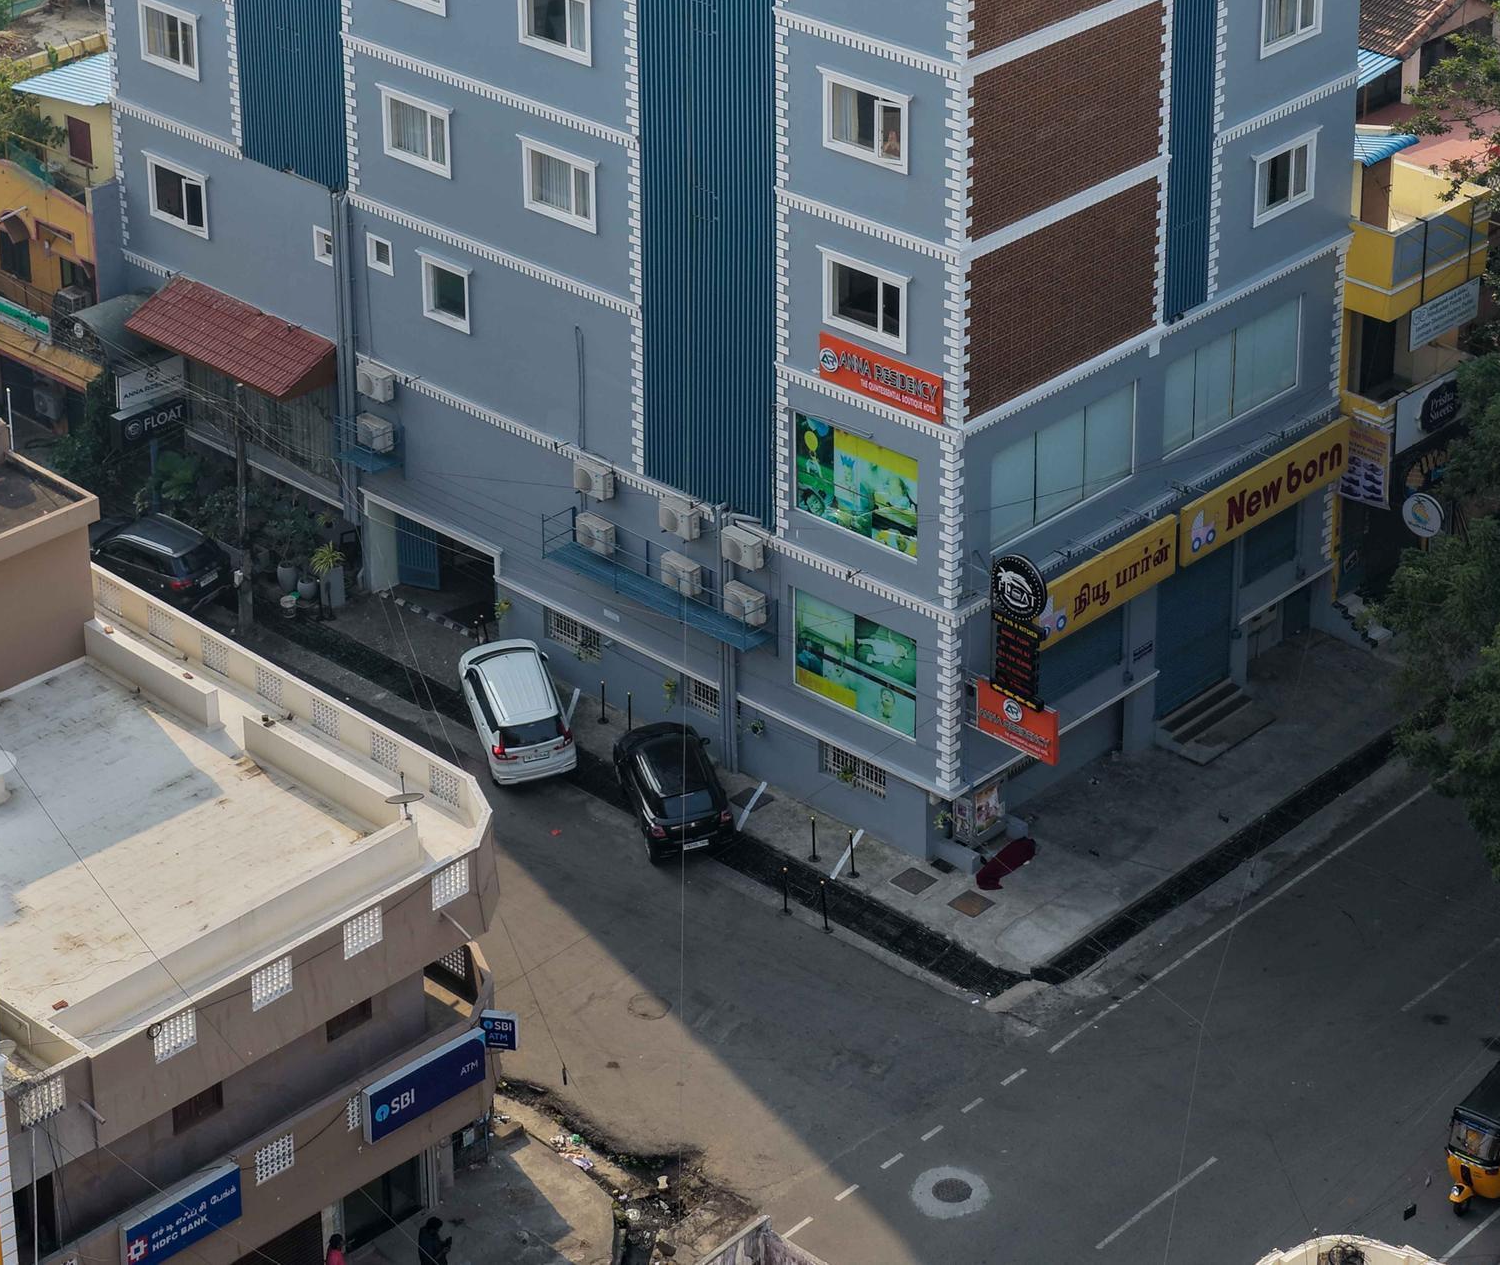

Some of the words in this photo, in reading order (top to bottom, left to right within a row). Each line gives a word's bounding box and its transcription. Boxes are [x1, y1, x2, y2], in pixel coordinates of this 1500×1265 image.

[838, 350, 872, 380] ANNA
[873, 362, 940, 403] RESIDENCY
[123, 388, 144, 400] ANNA
[901, 394, 924, 410] BOUTIQUE
[923, 402, 938, 415] HOTEL
[1430, 389, 1455, 411] Prisha
[143, 404, 184, 431] FLOAT
[1429, 402, 1455, 423] Sweets
[1225, 476, 1283, 531] New
[1286, 442, 1343, 494] born
[1073, 580, 1110, 621] நியூ
[1115, 538, 1172, 589] பார்ன்
[994, 613, 1003, 622] THE
[1018, 626, 1039, 639] KITCHEN
[488, 1032, 508, 1042] ATM
[494, 1020, 513, 1032] SBI
[390, 1088, 416, 1115] SBI
[459, 1059, 479, 1077] ATM
[151, 1231, 179, 1253] HDFC
[179, 1213, 209, 1237] BANK
